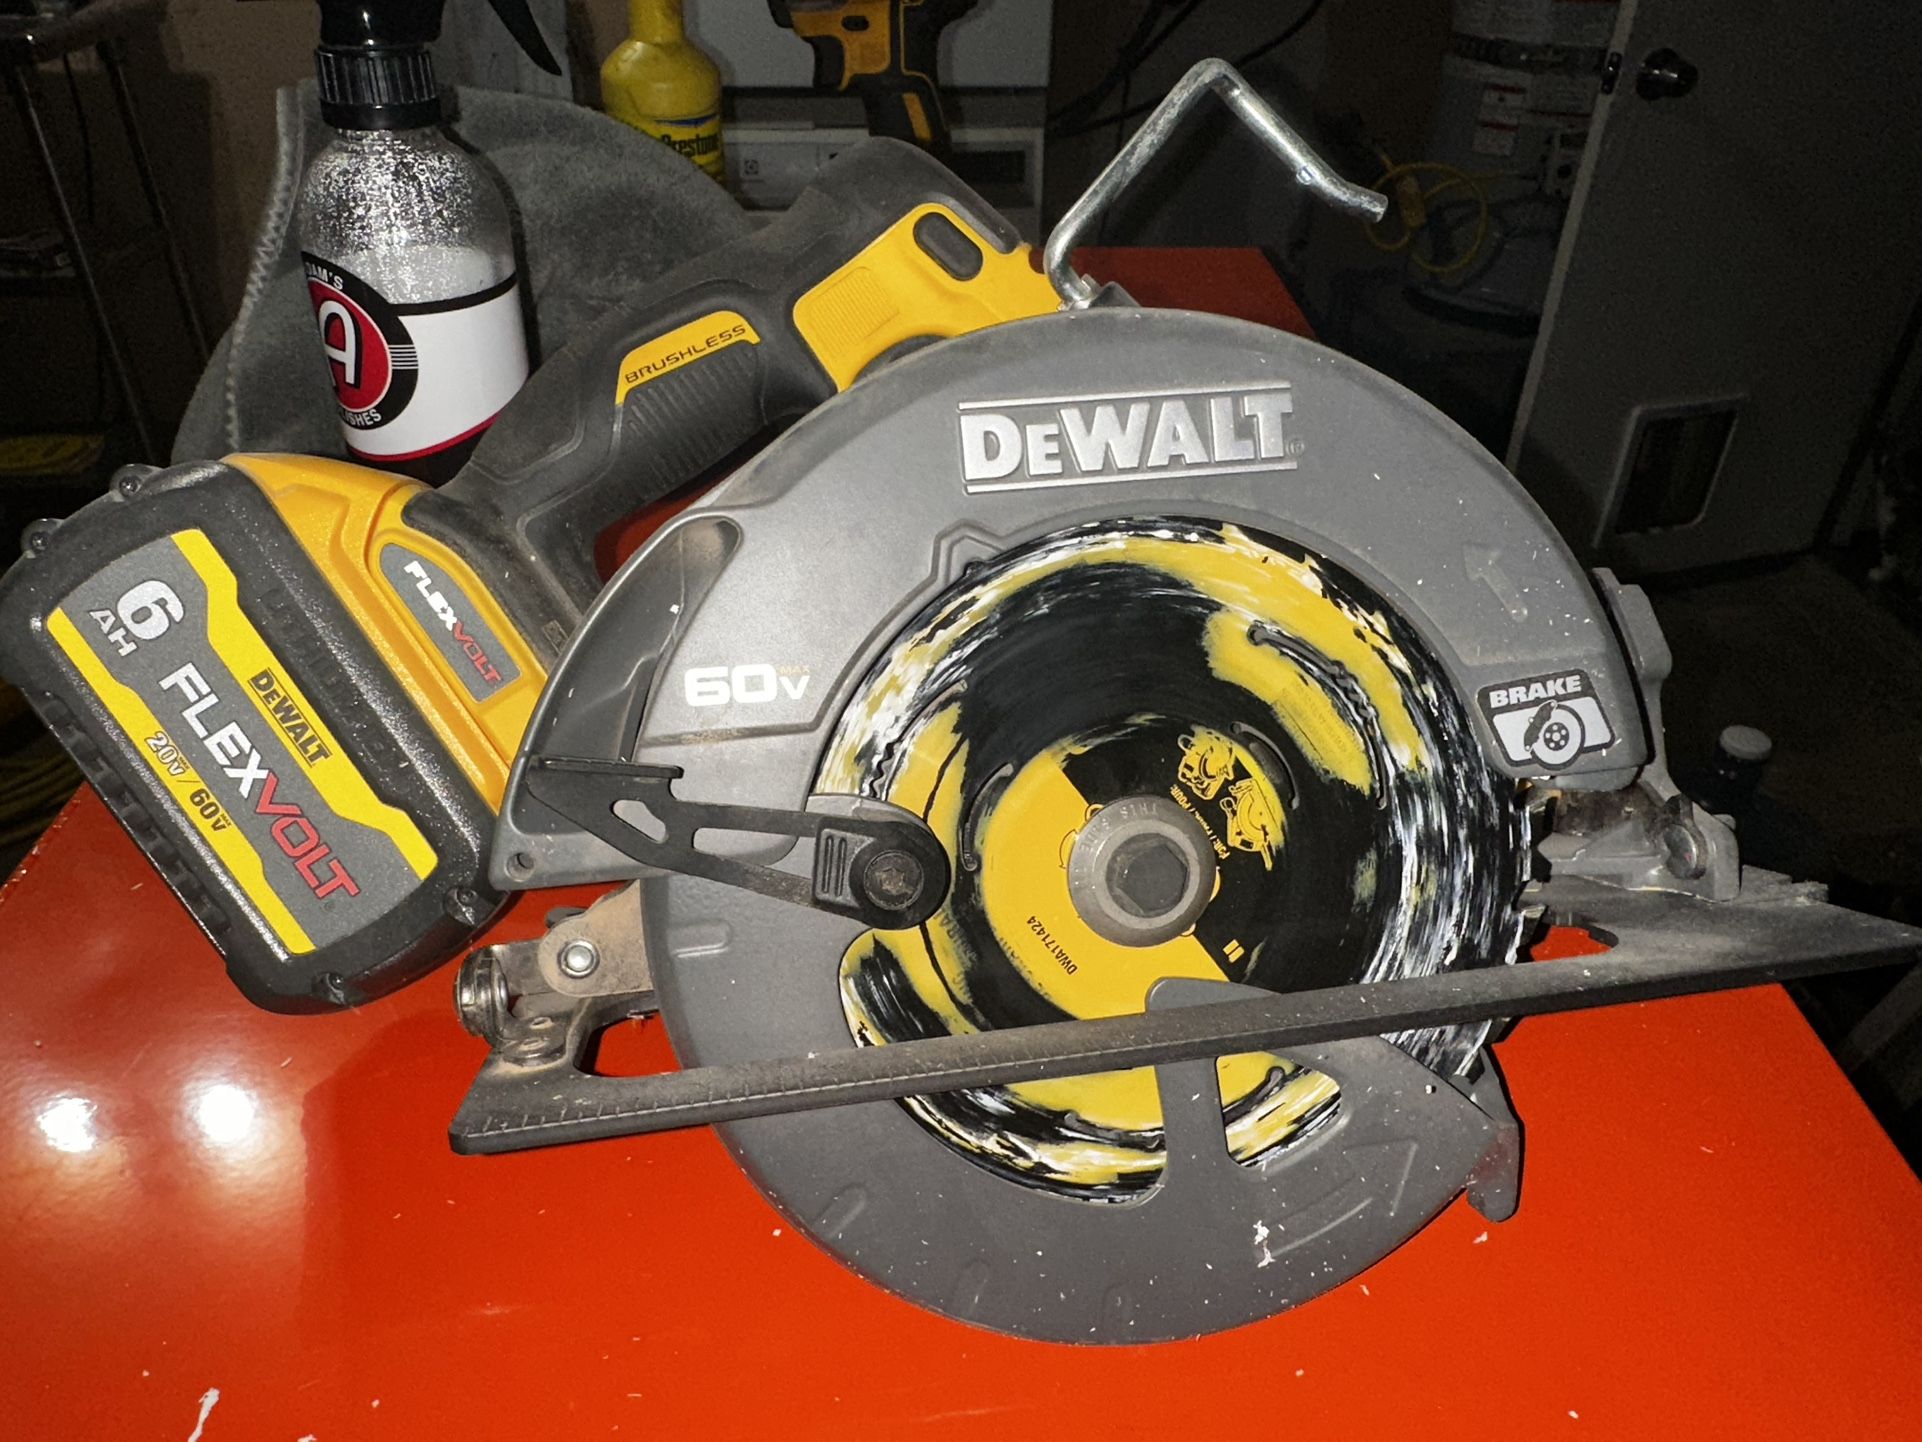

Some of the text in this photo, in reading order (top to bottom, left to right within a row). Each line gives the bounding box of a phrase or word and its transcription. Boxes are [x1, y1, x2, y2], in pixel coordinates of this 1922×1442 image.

[305, 262, 344, 290] DAM'S
[624, 324, 746, 384] BRUSHLESS
[89, 607, 138, 657] AH
[116, 580, 184, 641] 6
[403, 560, 502, 684] FLEXVOLT
[1489, 674, 1582, 709] BRAKE
[159, 662, 361, 899] FLEXVOLT
[1026, 915, 1078, 975] DWA171424
